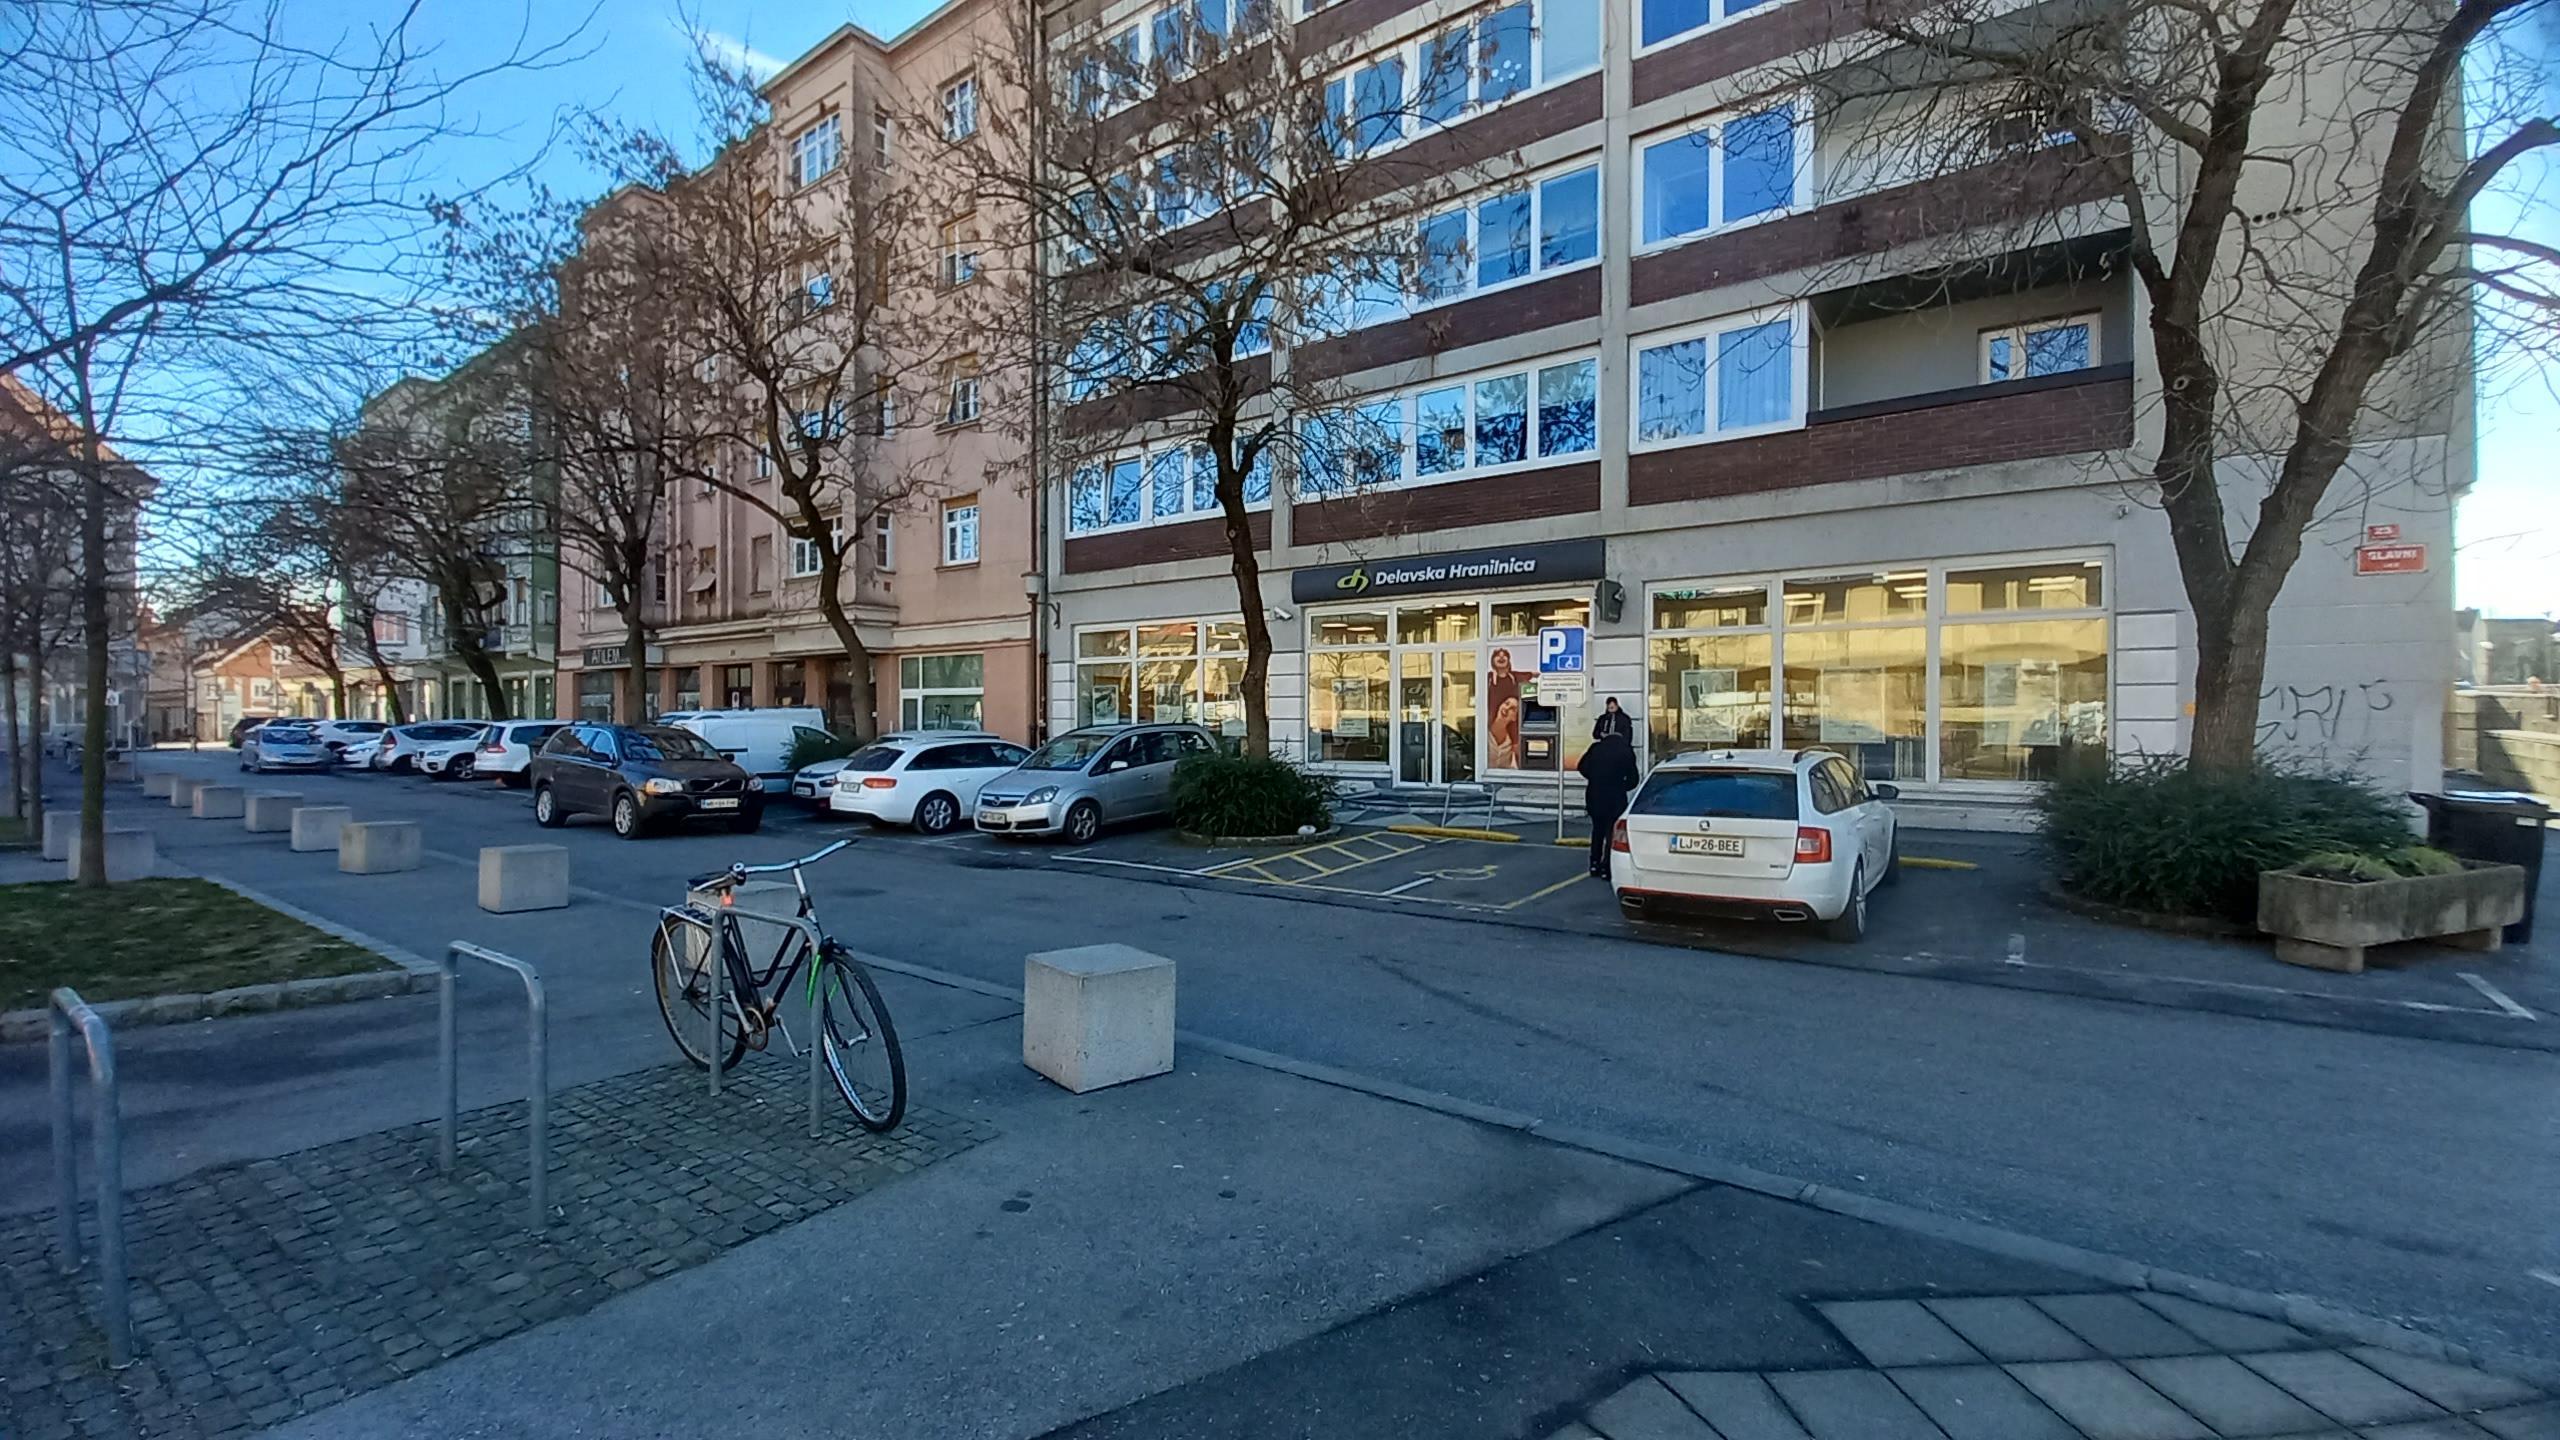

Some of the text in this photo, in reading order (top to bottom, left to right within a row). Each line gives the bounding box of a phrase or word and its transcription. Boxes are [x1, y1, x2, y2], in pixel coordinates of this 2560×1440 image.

[1375, 566, 1446, 586] Delavska
[1449, 557, 1536, 579] Hranilnica
[1542, 630, 1566, 664] P
[1679, 838, 1740, 852] LJ 26-BEE
